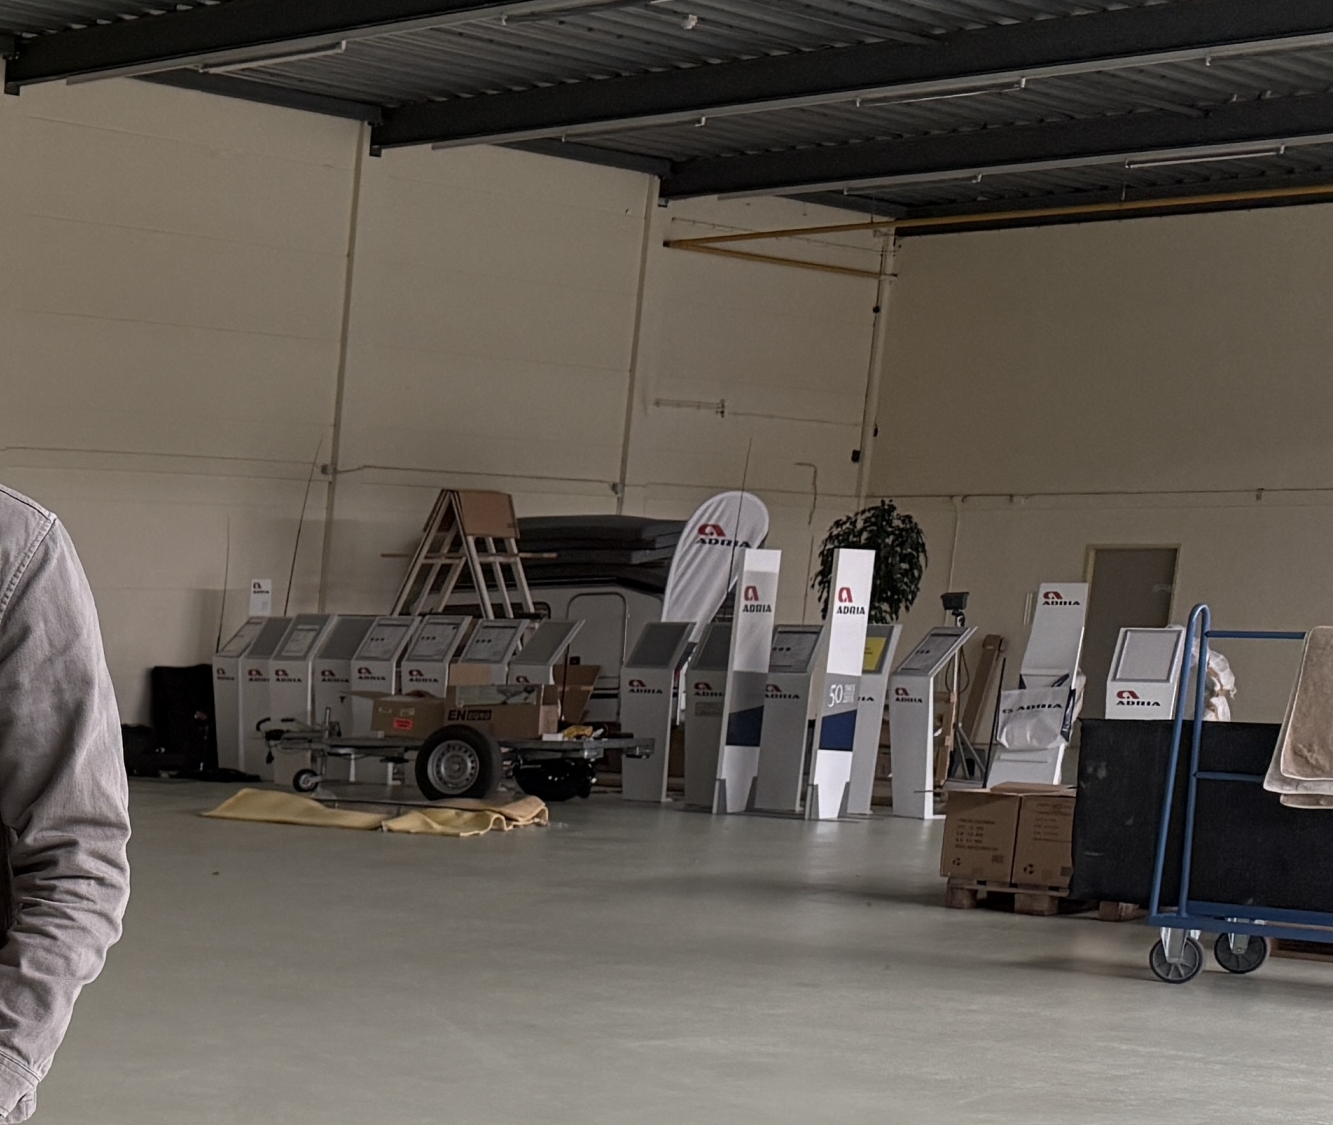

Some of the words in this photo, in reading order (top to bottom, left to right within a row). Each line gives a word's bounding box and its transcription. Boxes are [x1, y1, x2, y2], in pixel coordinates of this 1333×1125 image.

[696, 537, 752, 549] ADRIA
[742, 604, 772, 613] ADRIA
[836, 605, 866, 615] ADRIA
[828, 684, 843, 707] 50
[1017, 703, 1063, 712] ADRIA
